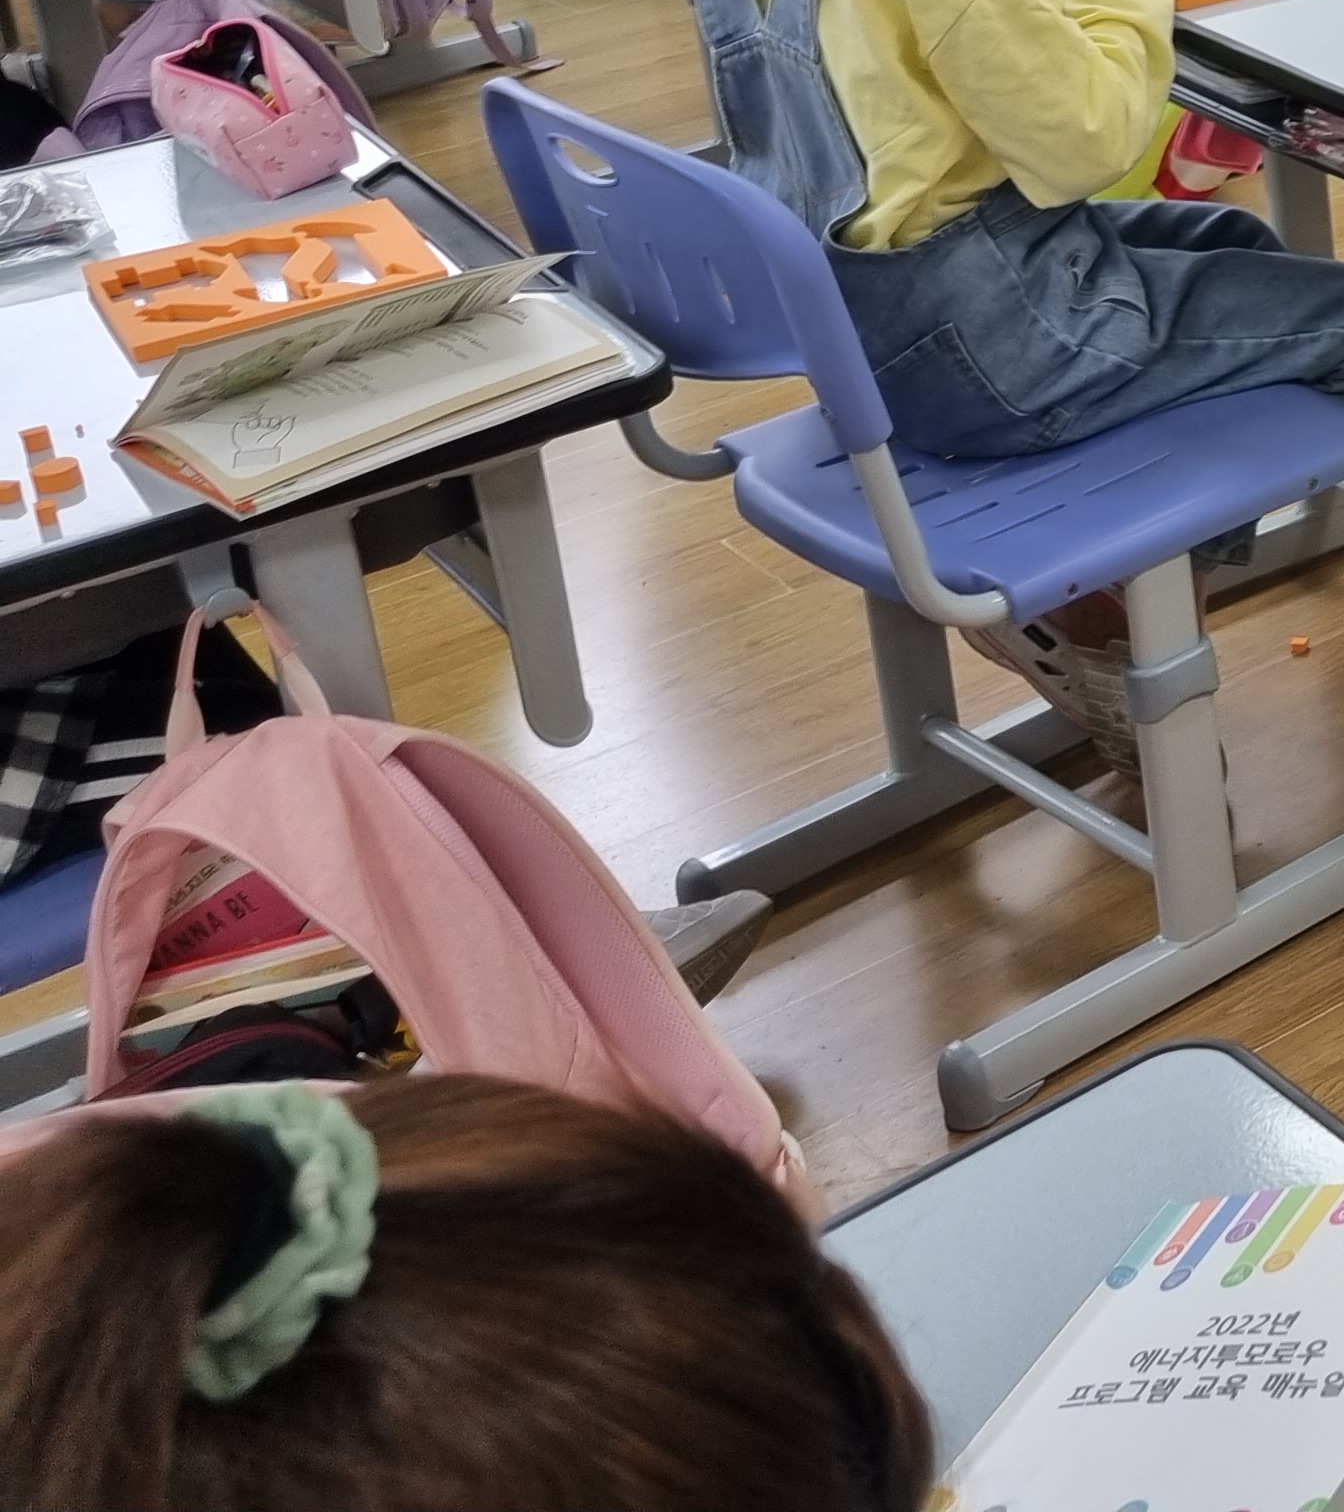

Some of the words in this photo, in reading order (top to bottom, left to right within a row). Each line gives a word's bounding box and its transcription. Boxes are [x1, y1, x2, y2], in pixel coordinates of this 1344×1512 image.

[222, 889, 260, 920] BE
[1196, 1310, 1301, 1338] 2022년
[1128, 1339, 1329, 1374] 에너지투모로우
[1058, 1377, 1182, 1409] 프로그램
[1183, 1374, 1249, 1401] 교육
